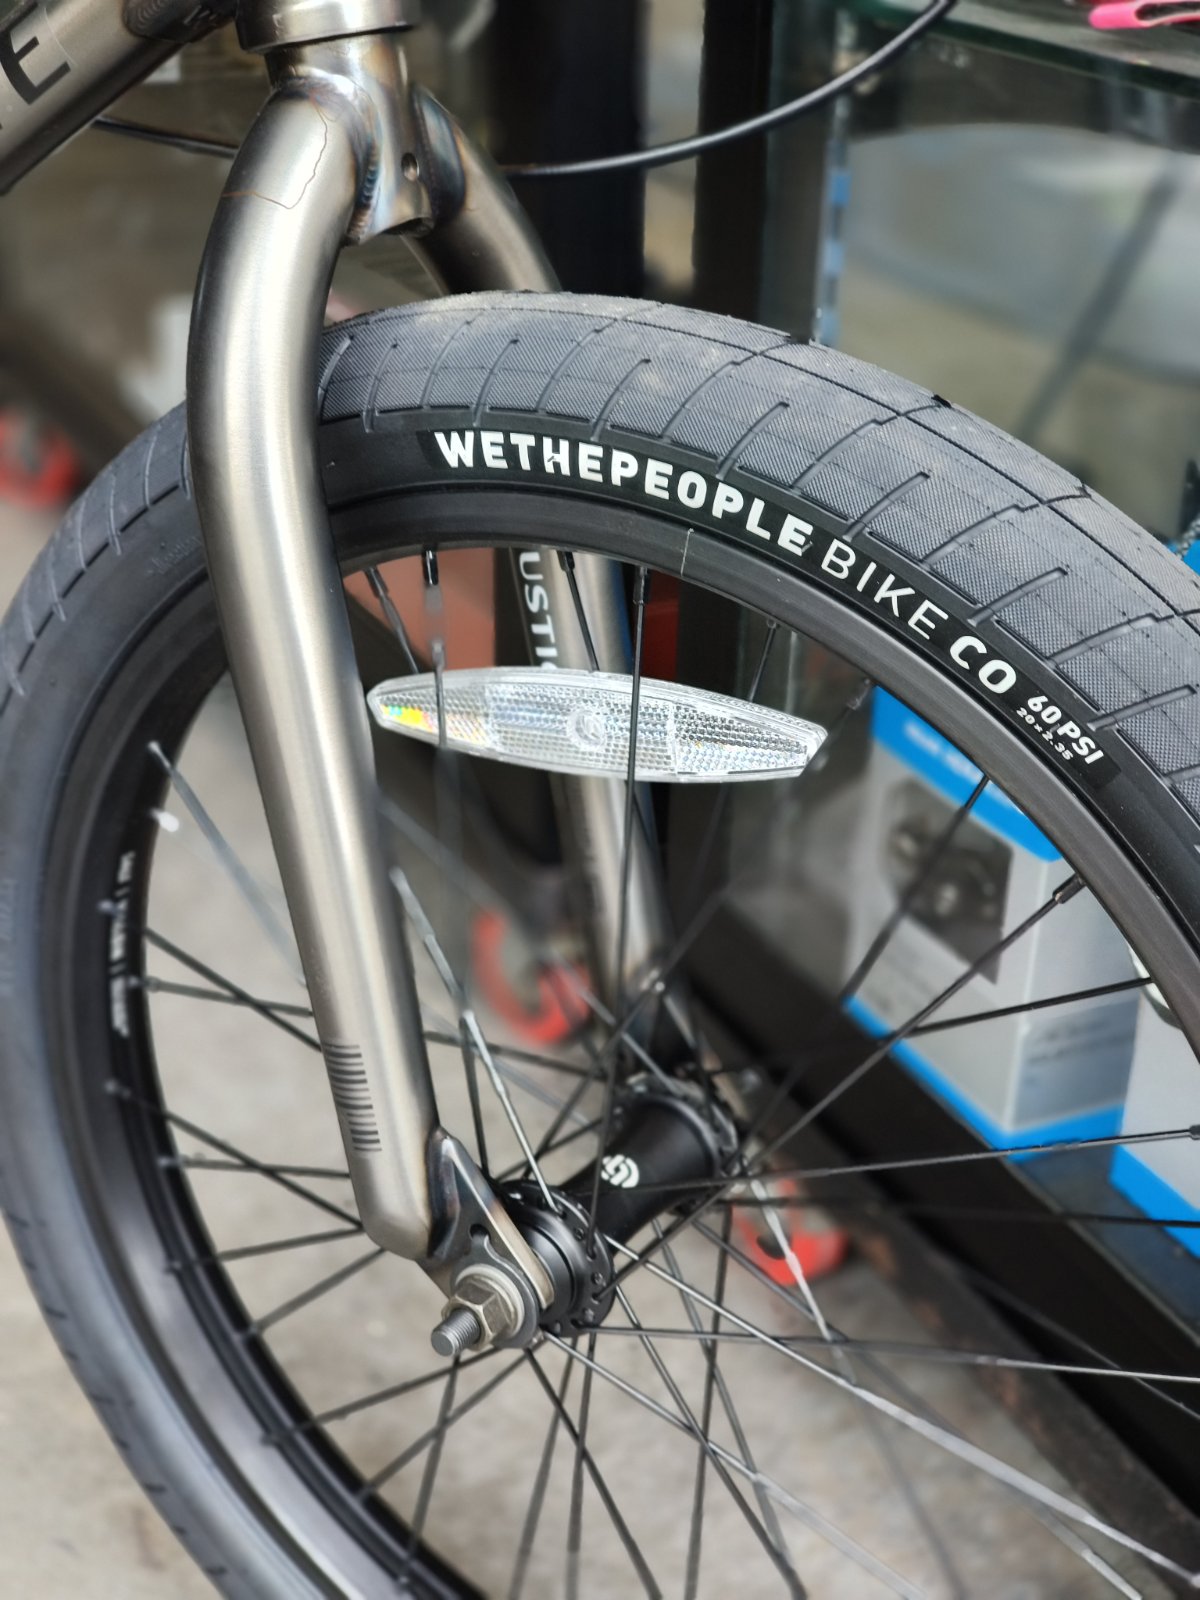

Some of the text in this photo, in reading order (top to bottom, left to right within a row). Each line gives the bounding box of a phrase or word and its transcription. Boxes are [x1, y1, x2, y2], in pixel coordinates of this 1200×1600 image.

[0, 0, 71, 130] E
[434, 431, 1016, 693] WETHEPEOPLE BIKE CO
[519, 551, 558, 669] USTI
